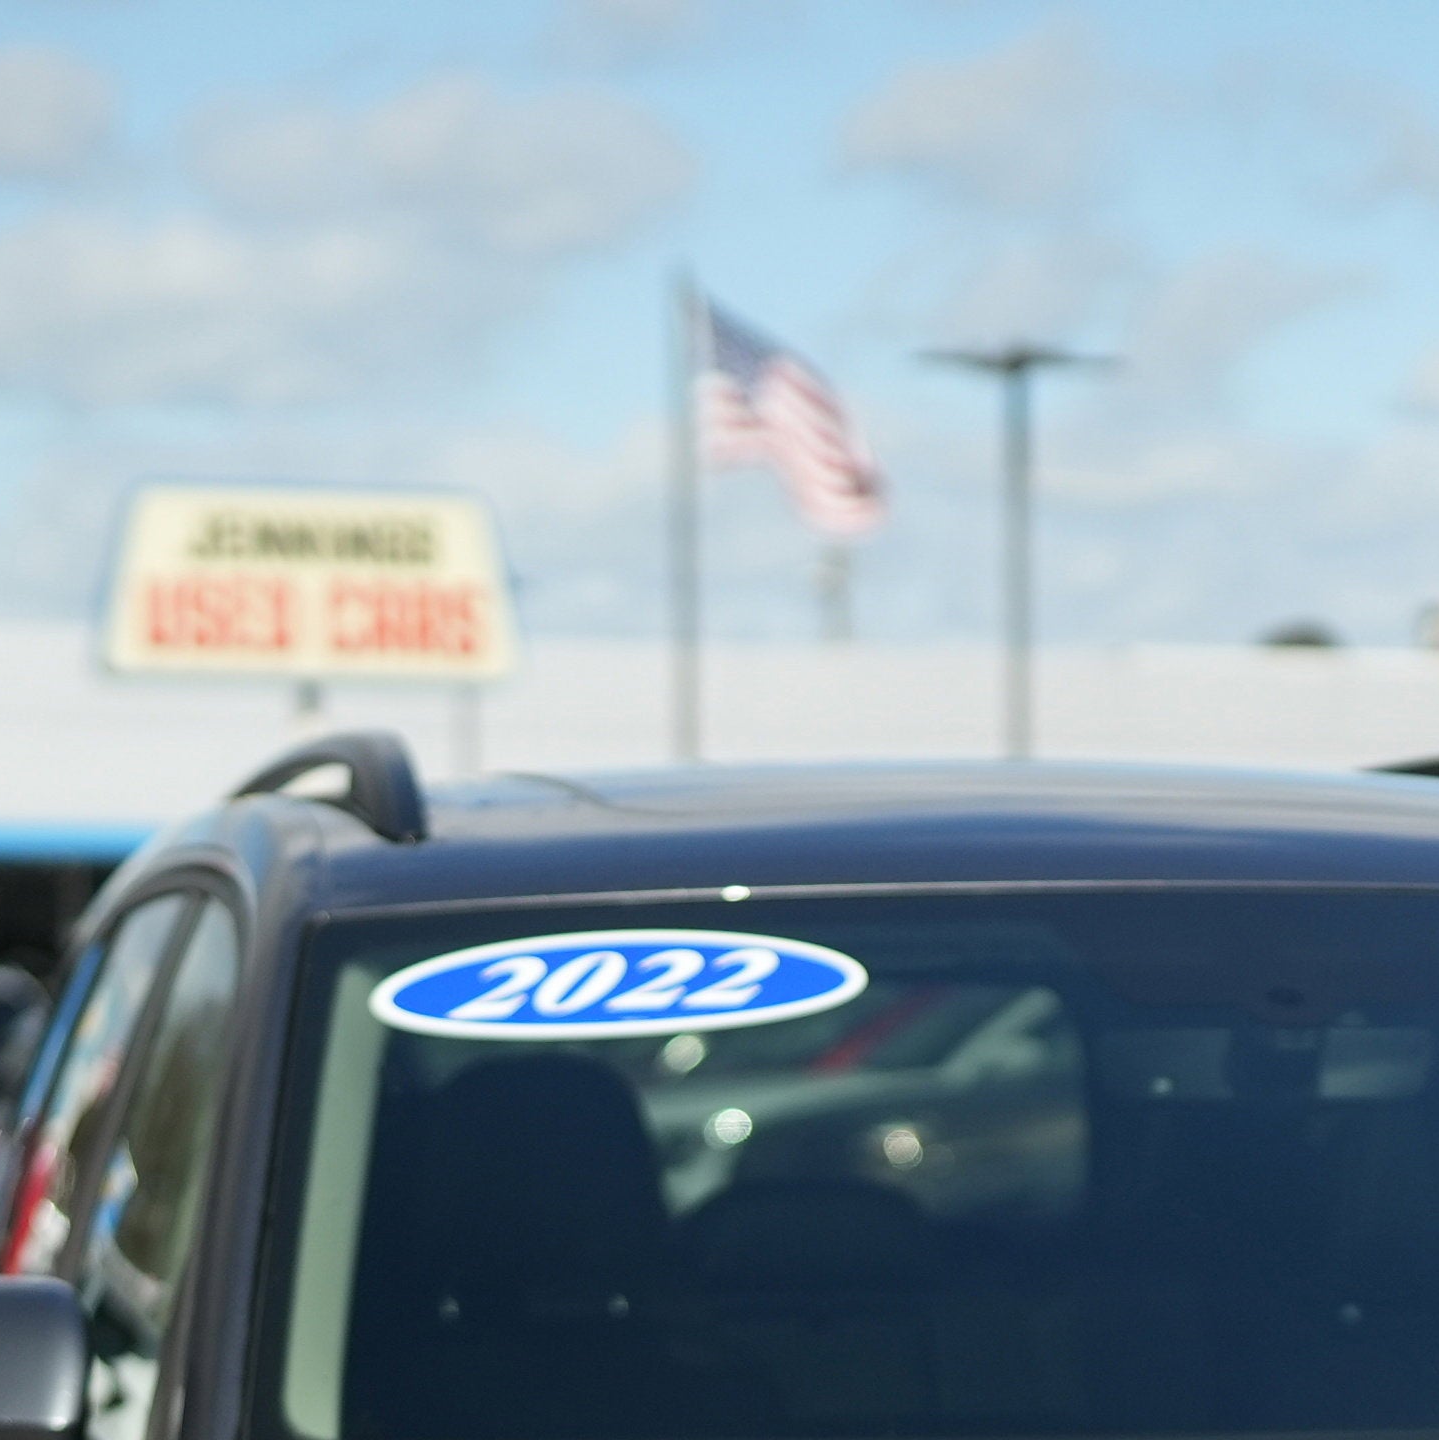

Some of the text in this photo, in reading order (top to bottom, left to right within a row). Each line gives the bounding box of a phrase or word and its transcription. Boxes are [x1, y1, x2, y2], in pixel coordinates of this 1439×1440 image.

[148, 577, 476, 654] USED CARS
[446, 946, 781, 1020] 2022
